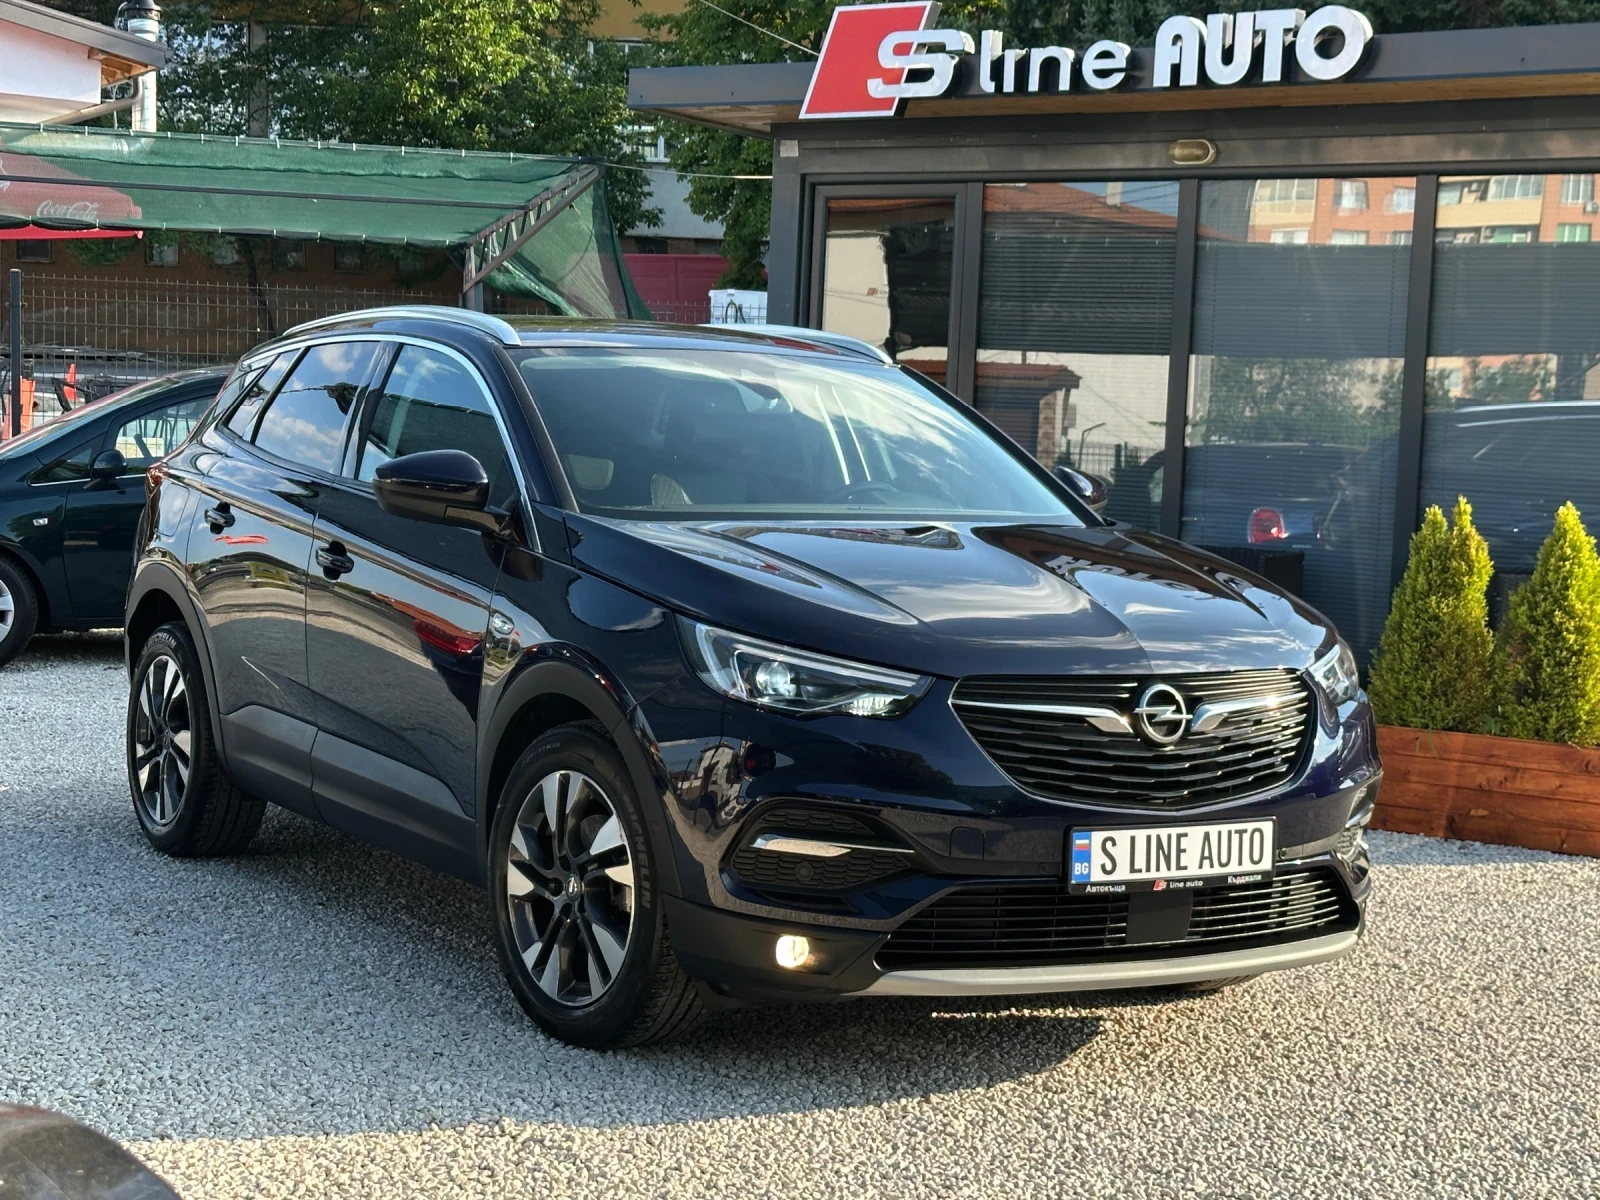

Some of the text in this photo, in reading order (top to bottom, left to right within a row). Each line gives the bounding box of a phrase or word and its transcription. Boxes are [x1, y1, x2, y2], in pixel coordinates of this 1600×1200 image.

[867, 5, 1373, 99] S line AUTO
[1100, 827, 1265, 876] S LINE AUTO
[1074, 862, 1089, 875] BG
[1185, 879, 1203, 888] auto
[1227, 873, 1262, 884] Кърджали
[1085, 883, 1126, 893] Автокъща
